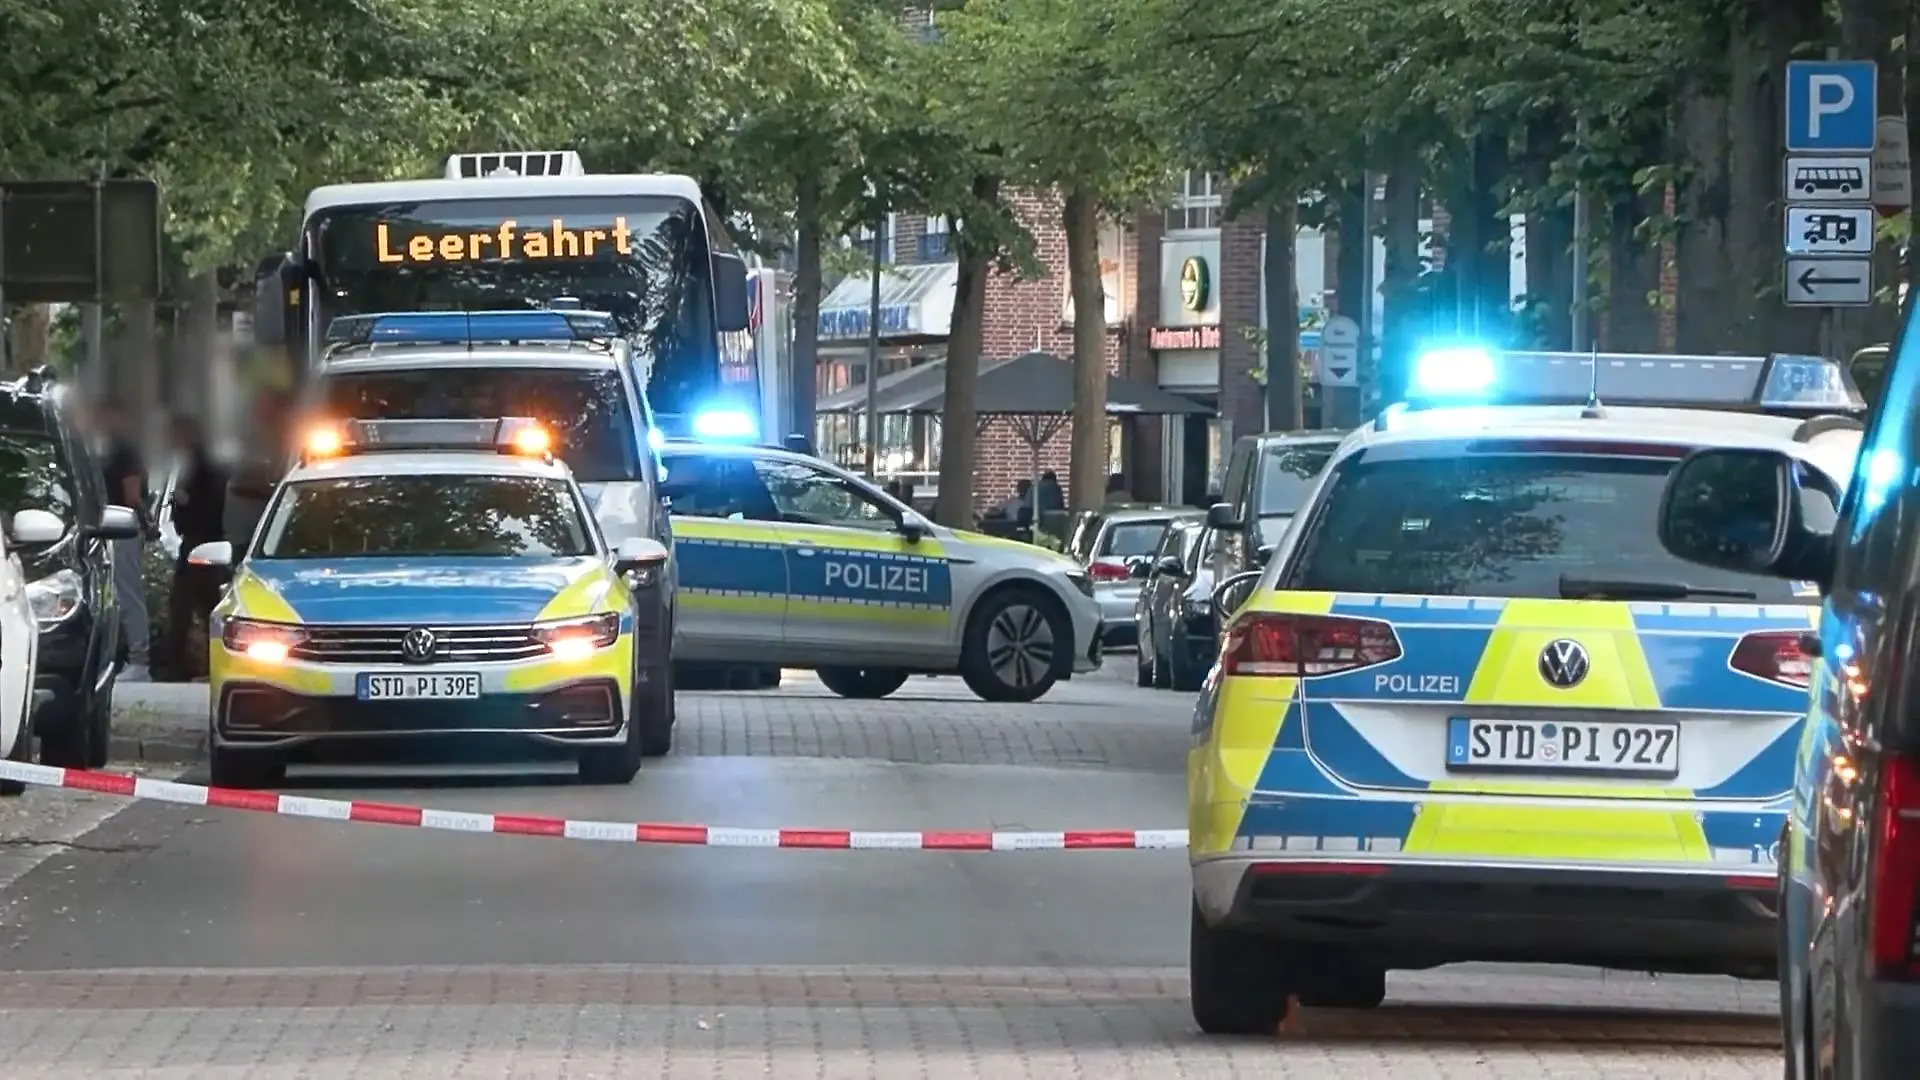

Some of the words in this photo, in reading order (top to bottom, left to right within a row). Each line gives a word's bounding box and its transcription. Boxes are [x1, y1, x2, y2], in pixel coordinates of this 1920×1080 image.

[1808, 73, 1854, 139] P
[376, 217, 632, 263] Leerfahrt
[825, 561, 929, 593] POLIZEI
[370, 677, 404, 696] STD
[417, 677, 438, 696] PI
[444, 677, 476, 696] 39E
[1374, 674, 1460, 694] POLIZEI
[1472, 724, 1535, 760] STD
[1562, 726, 1601, 762] PI
[1612, 728, 1675, 764] 927
